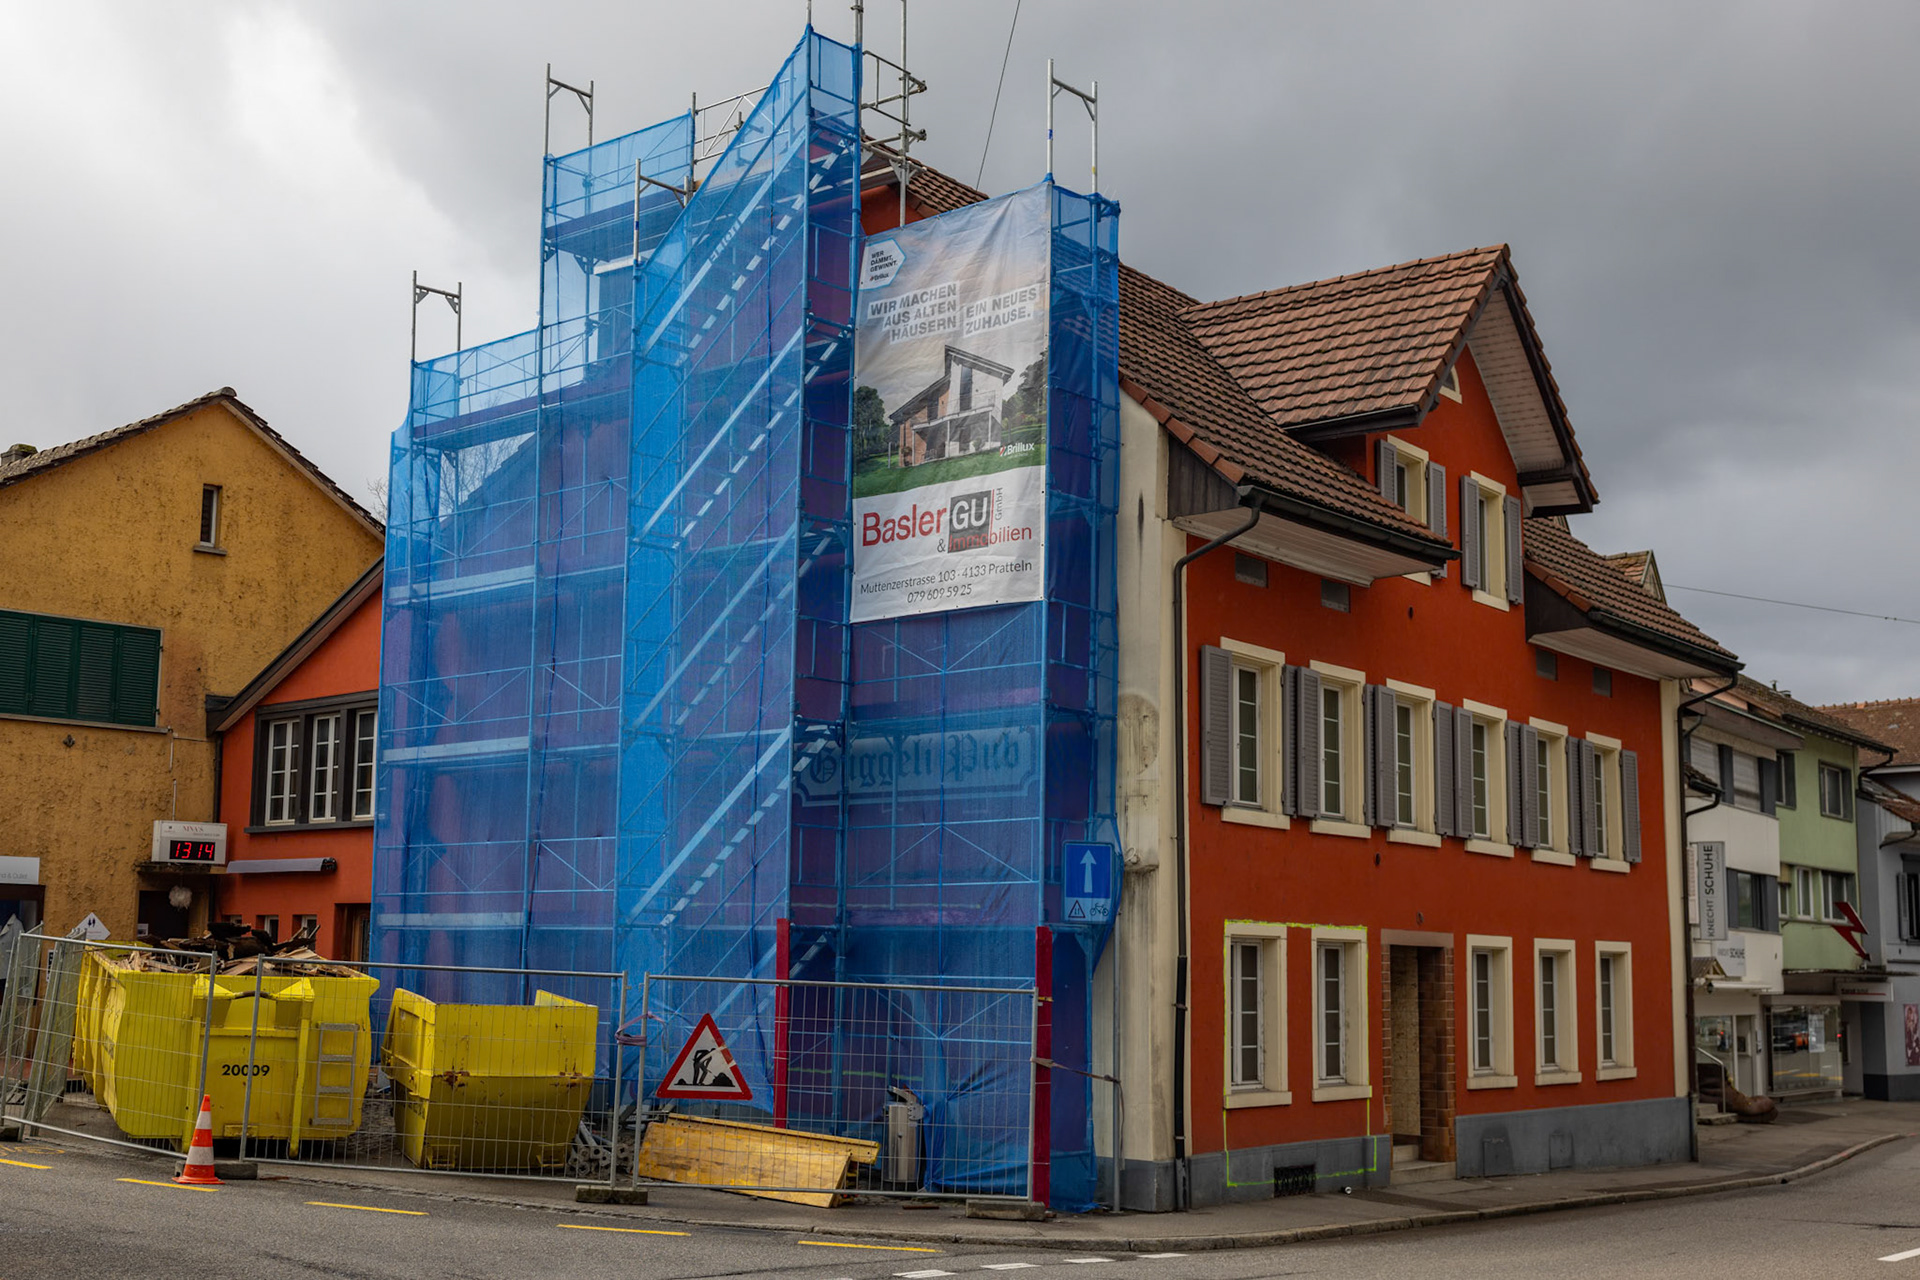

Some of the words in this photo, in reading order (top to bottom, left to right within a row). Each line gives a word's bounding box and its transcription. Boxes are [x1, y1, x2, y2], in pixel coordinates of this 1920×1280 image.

[871, 250, 885, 259] WER
[870, 301, 897, 316] WIR
[900, 283, 957, 309] MACHEN
[884, 310, 911, 327] AUS
[913, 300, 957, 321] ALTEN
[965, 302, 987, 318] EIN
[991, 287, 1037, 311] NEUES
[891, 315, 957, 342] HÄUSERN
[965, 305, 1031, 335] ZUHAUSE.
[1007, 442, 1035, 455] Brillux
[994, 487, 1003, 521] GmbH
[862, 504, 947, 547] Basler
[951, 497, 988, 530] GU
[936, 538, 946, 553] &
[948, 525, 1032, 552] Immobilien
[860, 574, 936, 595] Muttenzerstrasse
[938, 569, 956, 583] 103
[962, 564, 987, 578] 4133
[989, 560, 1033, 575] Pratteln
[907, 589, 925, 604] 079
[926, 586, 945, 601] 609
[947, 585, 960, 598] 59
[960, 583, 972, 596] 25
[945, 732, 1019, 781] Pub
[1703, 844, 1715, 895] SCHUHE
[1706, 899, 1715, 938] KNECHT
[221, 1064, 271, 1077] 20009
